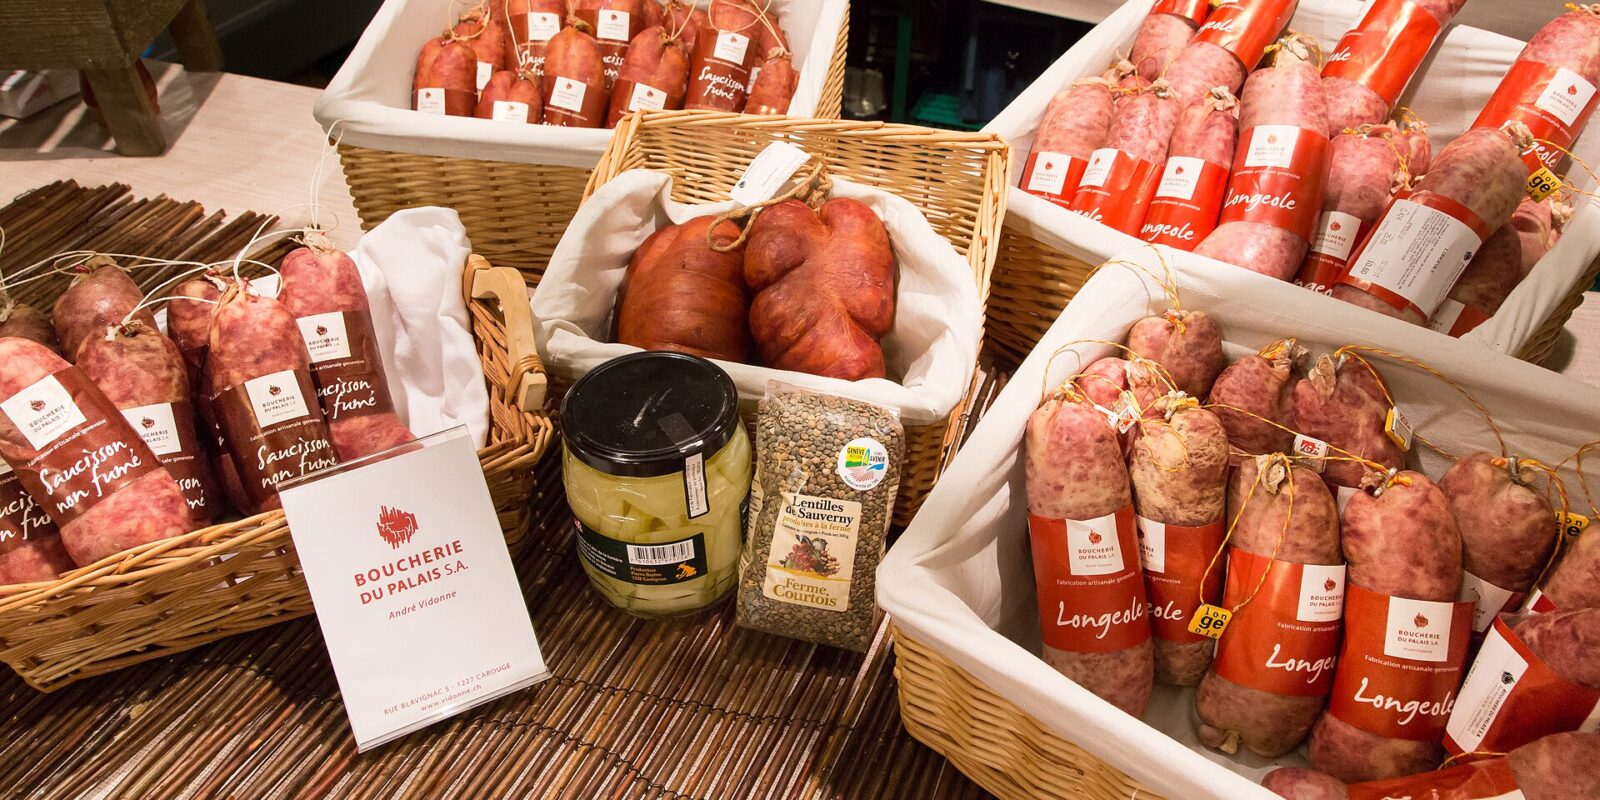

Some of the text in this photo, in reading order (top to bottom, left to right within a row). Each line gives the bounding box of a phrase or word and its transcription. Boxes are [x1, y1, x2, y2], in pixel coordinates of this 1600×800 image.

[698, 66, 745, 92] Saucisson
[703, 81, 735, 100] fumé
[1522, 141, 1560, 168] geole
[1528, 176, 1551, 193] ge
[1224, 188, 1296, 212] Longeole
[318, 377, 371, 397] ucisson
[262, 395, 296, 408] BOUCHERIE
[333, 390, 376, 419] fumé
[142, 430, 168, 438] UCHERIE
[257, 437, 330, 471] Saucisson
[39, 440, 127, 496] Saucisson
[262, 450, 337, 488] non fumé
[56, 448, 141, 514] non fumé
[186, 489, 205, 509] mé
[792, 496, 844, 513] Lentilles
[785, 505, 854, 527] de Sauverny
[820, 521, 828, 530] la
[829, 523, 852, 533] ferme
[1078, 546, 1115, 554] BOUCHERIE
[354, 540, 463, 587] BOUCHERIE
[360, 560, 469, 605] DU PALAIS S.A.
[785, 577, 827, 595] Ferme
[1088, 578, 1116, 586] artisanale
[388, 591, 457, 620] André Vidonne
[773, 584, 837, 607] Courtois
[1056, 595, 1144, 639] Longeole
[1199, 615, 1224, 629] ge
[1277, 621, 1312, 632] Fabrication
[1398, 629, 1441, 640] BOUCHERIE
[1408, 638, 1429, 646] PALAIS
[1364, 654, 1400, 668] Fabrication
[1402, 664, 1433, 672] artisanale
[383, 706, 398, 715] RUE
[400, 688, 443, 710] BLAVIGNAC
[456, 677, 475, 688] 1227
[475, 662, 512, 681] CAROUGE
[421, 684, 482, 711] www.vidonne.ch
[1354, 677, 1454, 725] Longeole
